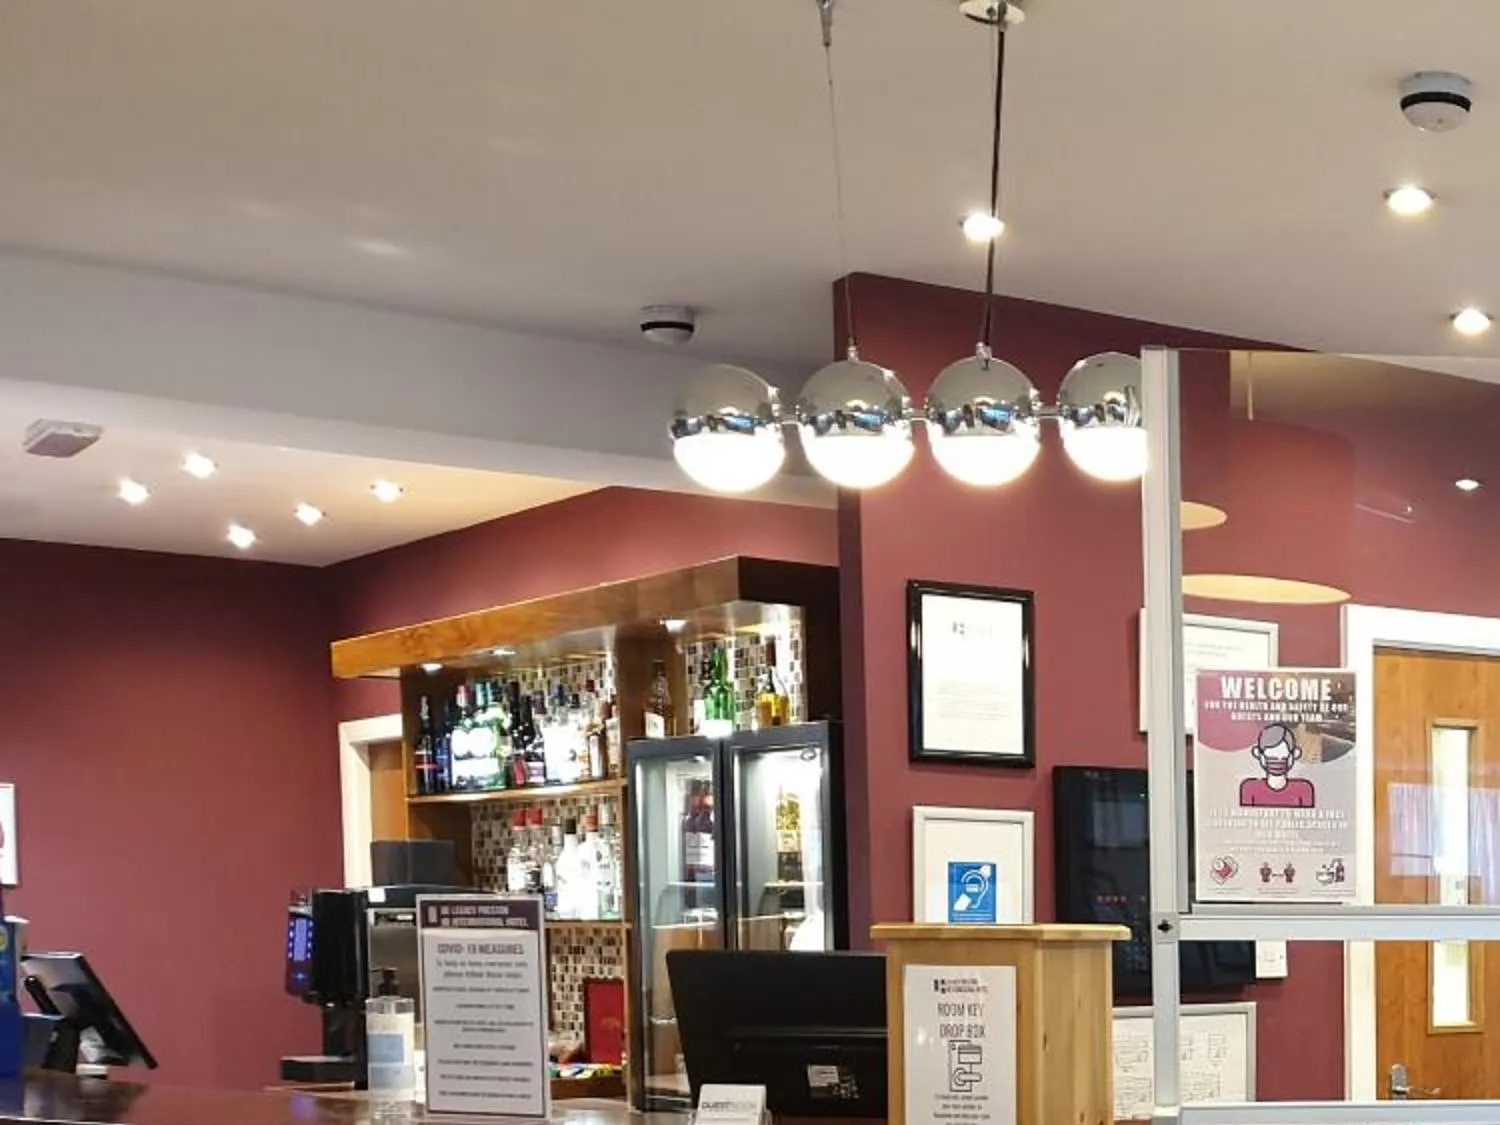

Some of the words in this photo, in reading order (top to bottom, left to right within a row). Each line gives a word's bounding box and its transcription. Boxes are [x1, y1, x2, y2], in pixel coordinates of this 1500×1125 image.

[1221, 676, 1333, 700] WELCOME
[937, 1002, 965, 1017] ROOM
[939, 1023, 965, 1038] DROP
